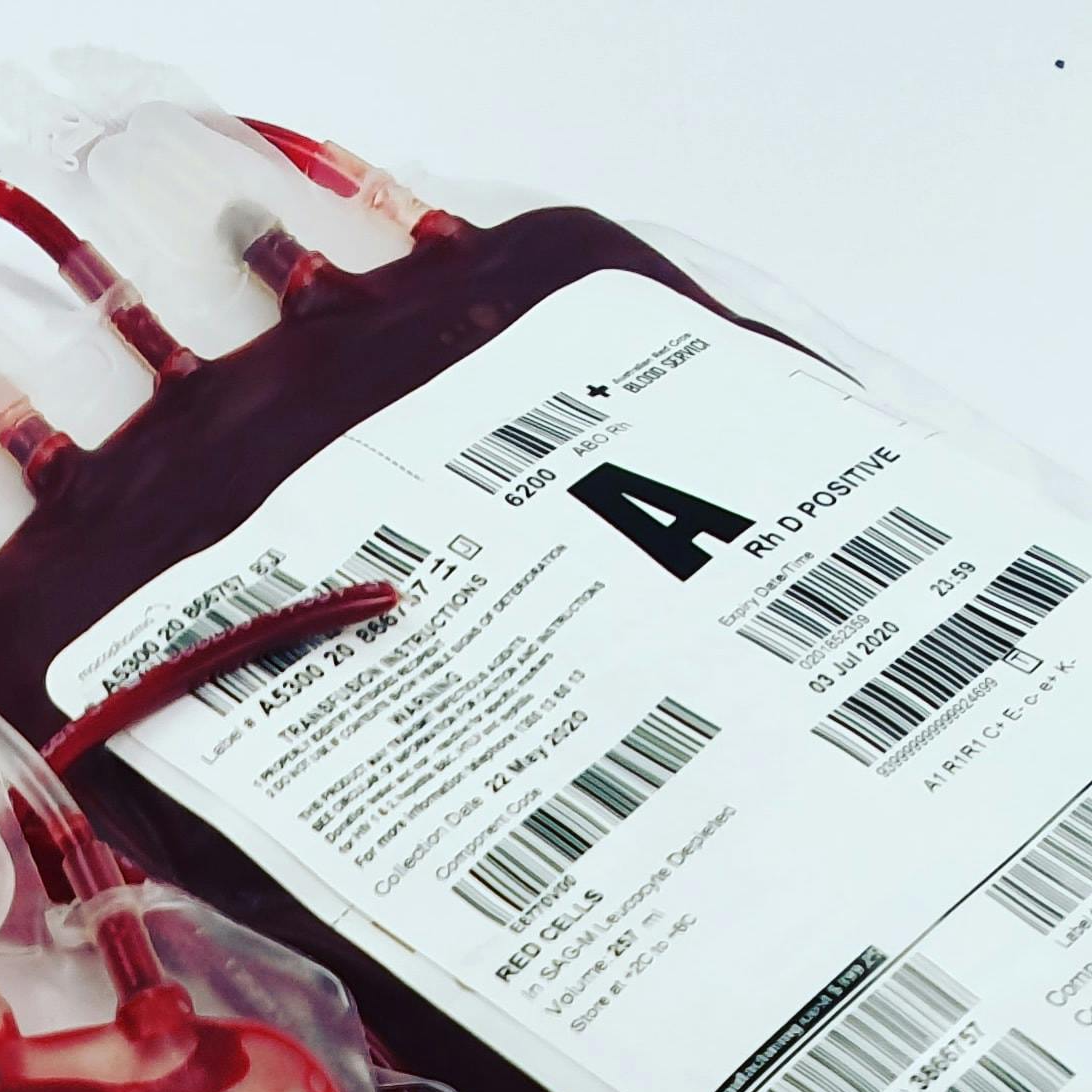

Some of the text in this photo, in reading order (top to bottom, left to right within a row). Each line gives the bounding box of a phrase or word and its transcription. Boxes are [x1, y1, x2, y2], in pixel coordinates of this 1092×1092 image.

[623, 367, 666, 394] BLOOD
[573, 421, 633, 457] ABO Rh
[504, 469, 557, 507] 6200
[567, 462, 756, 582] A
[744, 447, 901, 558] Rh D POSITIVE
[718, 550, 815, 628] Expiry Date/Time
[809, 561, 977, 694] 03 Jul 2020 23:59
[101, 641, 159, 697] A5300
[158, 618, 185, 640] 20
[259, 557, 458, 717] A5300 20 11
[923, 773, 948, 792] A1
[943, 740, 986, 775] R1R1
[983, 721, 1005, 739] C+
[375, 826, 446, 896] Collection
[485, 772, 510, 794] 22
[496, 888, 604, 982] RED CELLS
[608, 929, 637, 957] 257
[571, 996, 610, 1033] Store
